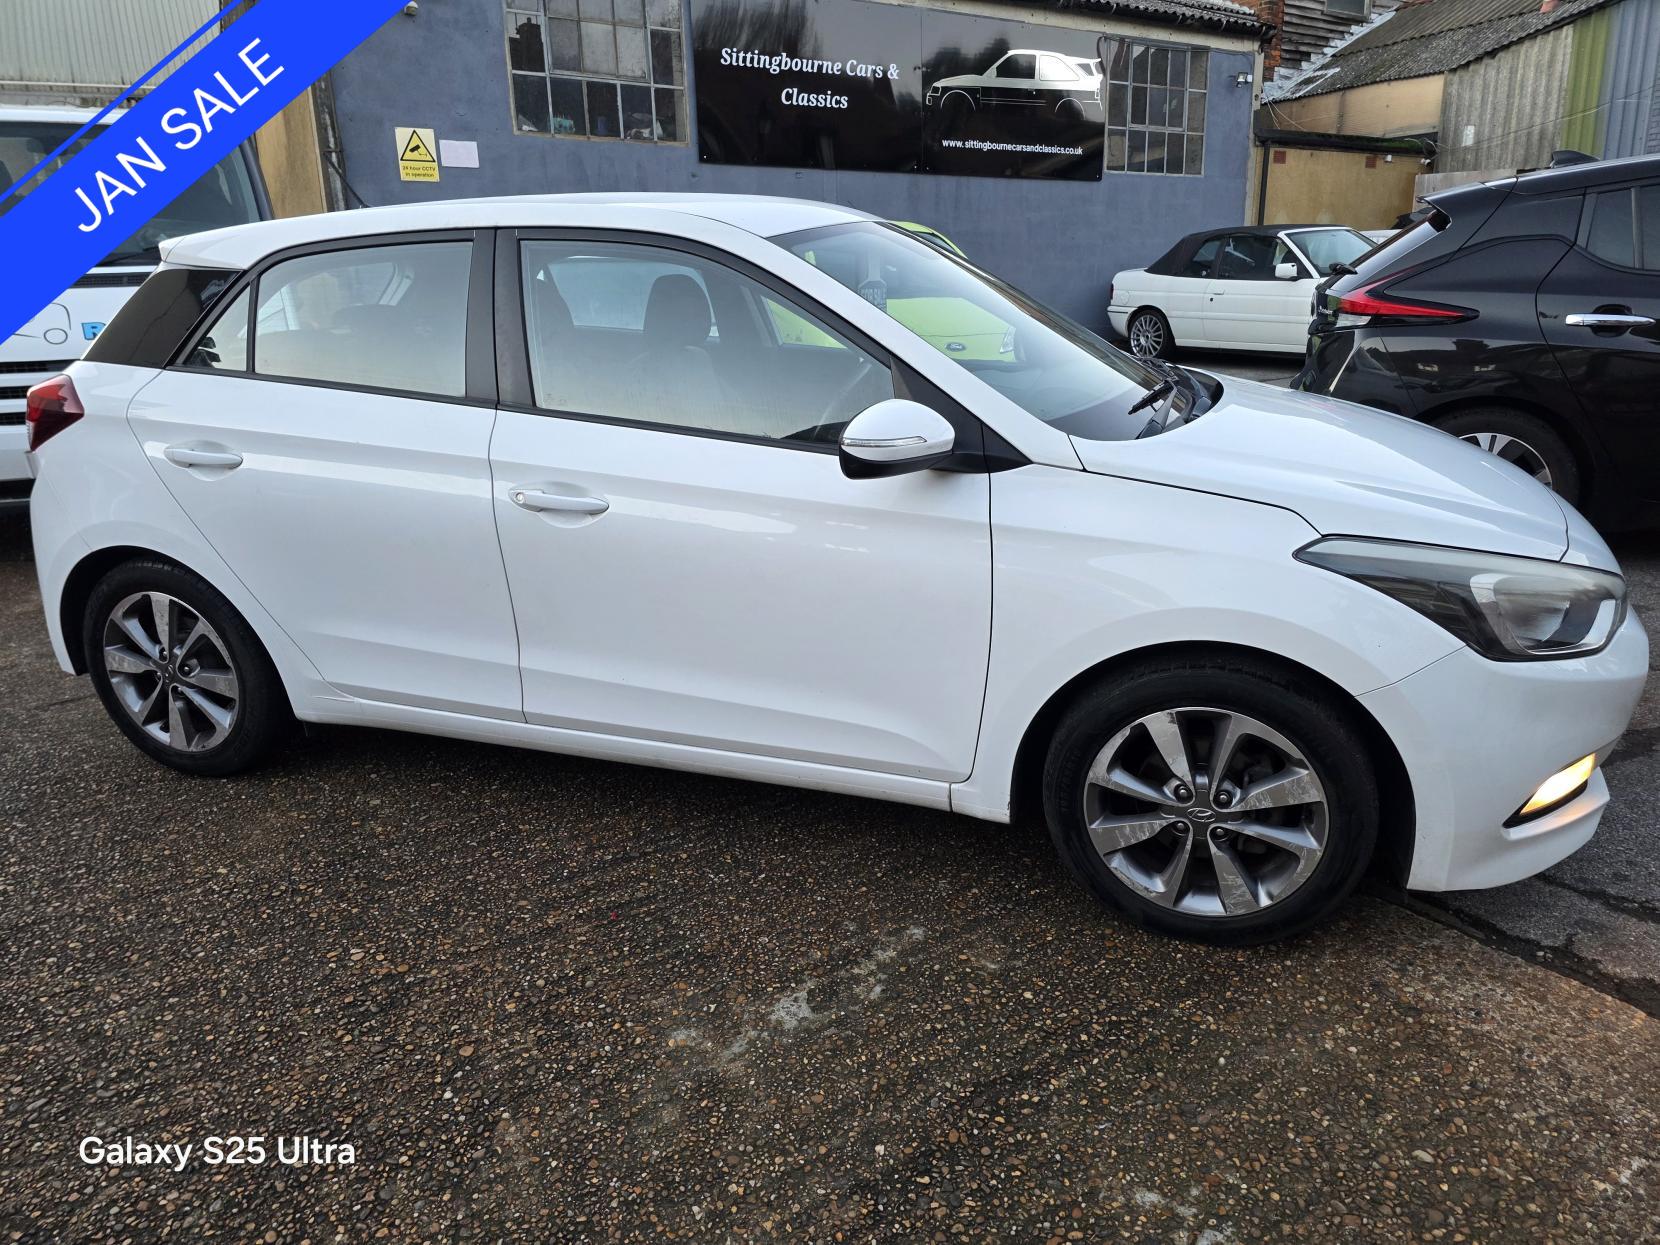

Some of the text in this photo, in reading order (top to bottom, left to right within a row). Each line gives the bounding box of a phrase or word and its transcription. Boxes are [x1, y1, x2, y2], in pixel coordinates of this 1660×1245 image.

[720, 48, 900, 80] Sittingbourne Cars &
[781, 88, 849, 109] Classics
